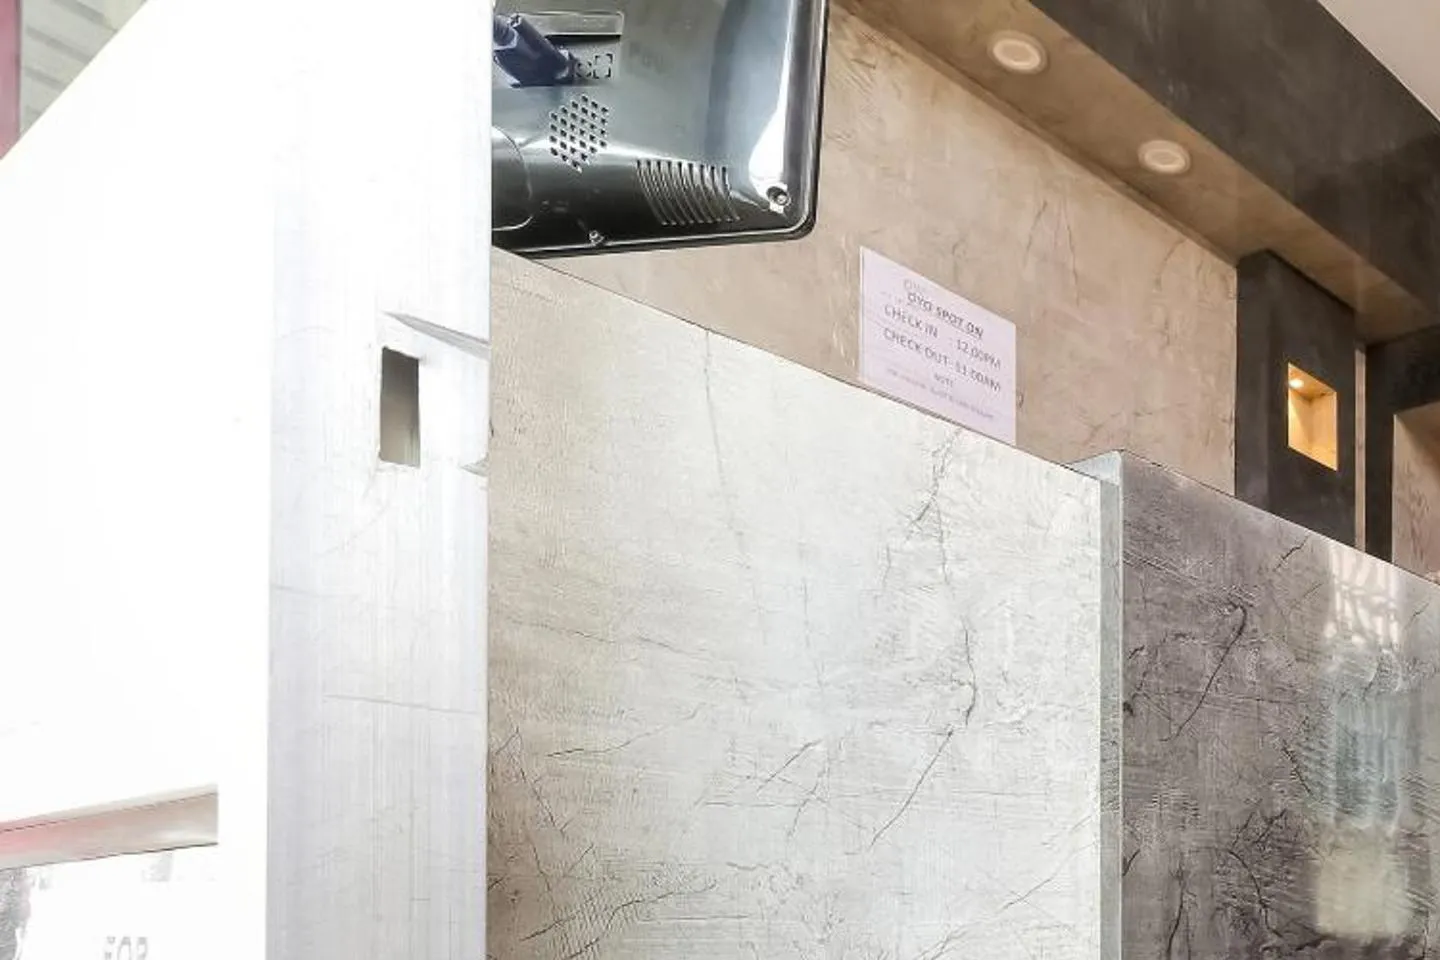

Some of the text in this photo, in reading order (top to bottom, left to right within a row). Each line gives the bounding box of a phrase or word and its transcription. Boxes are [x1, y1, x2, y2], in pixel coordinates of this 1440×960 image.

[884, 304, 922, 330] CHECK
[924, 322, 938, 338] IN
[936, 306, 964, 327] SPOT
[966, 321, 984, 339] ON
[883, 327, 922, 353] CHECK
